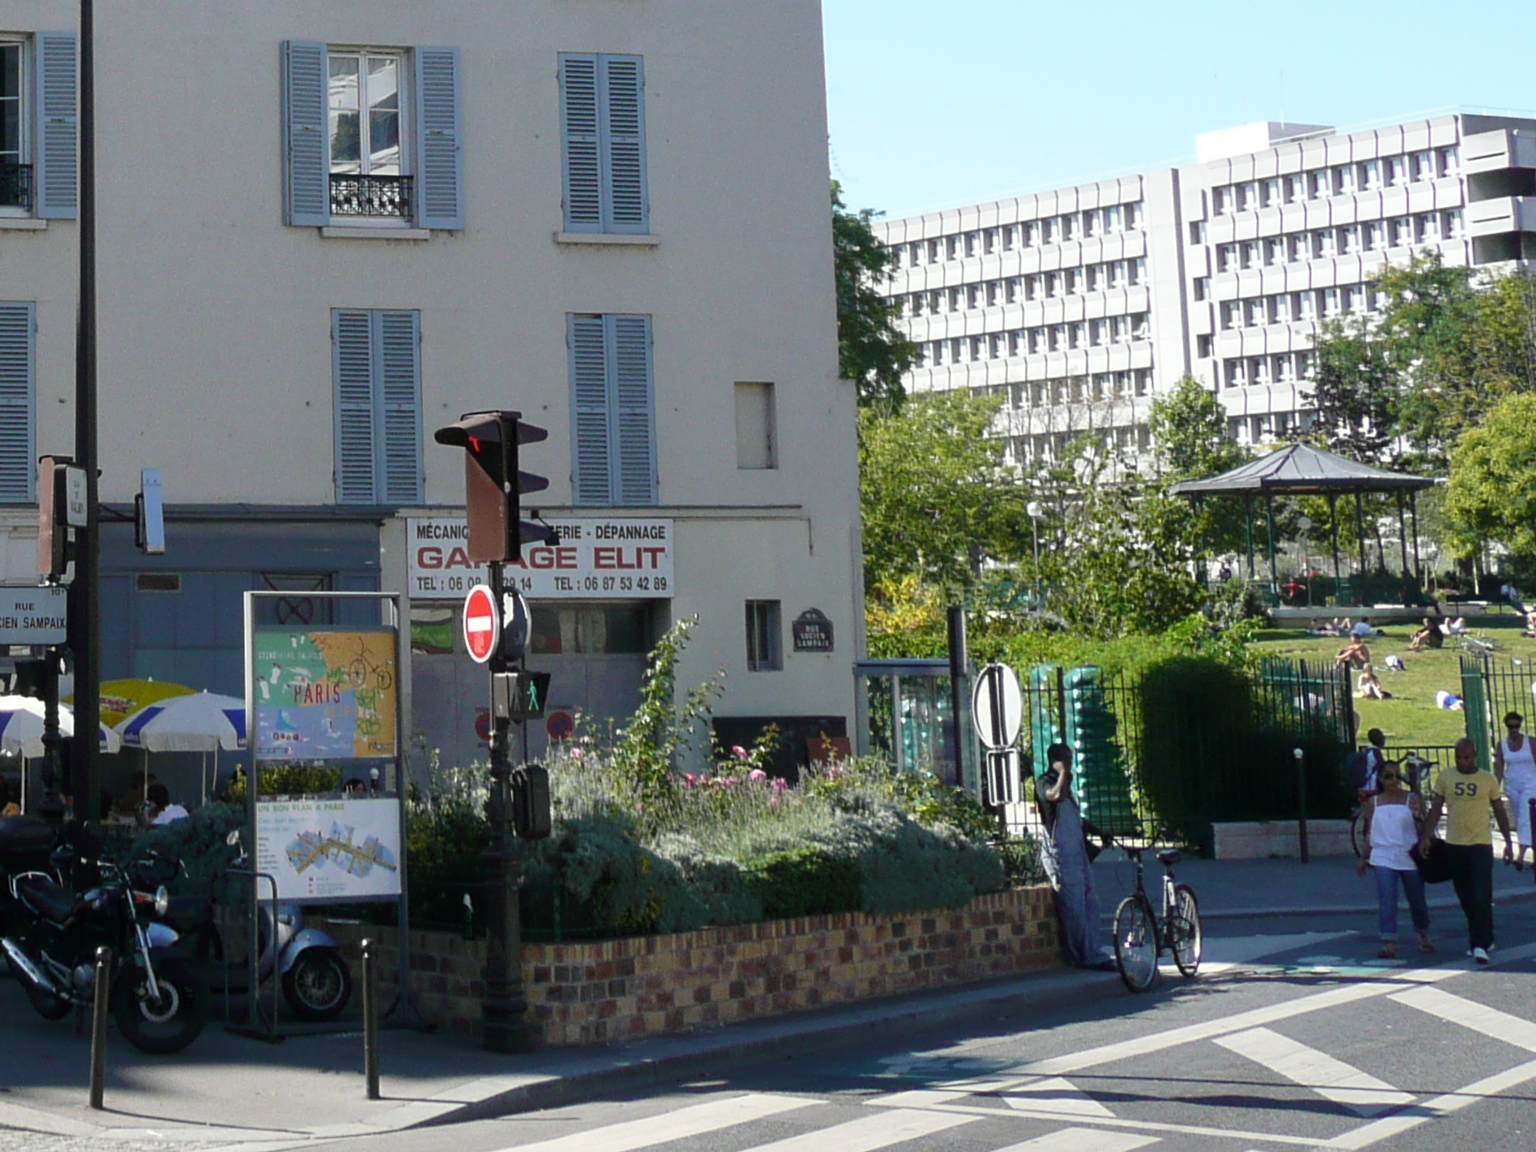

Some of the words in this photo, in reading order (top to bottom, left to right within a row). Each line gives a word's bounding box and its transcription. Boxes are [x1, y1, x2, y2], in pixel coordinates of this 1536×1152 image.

[553, 525, 582, 539] ERIE
[596, 522, 666, 539] DÉPANNAGE
[417, 547, 577, 569] GAAGE
[594, 547, 666, 569] ELIT
[417, 576, 437, 591] TEL
[448, 576, 463, 591] 06
[520, 577, 532, 591] 14
[554, 576, 574, 591] TEL
[584, 576, 598, 591] 06
[603, 576, 615, 591] 87
[620, 576, 632, 591] 53
[637, 576, 649, 591] 42
[654, 576, 667, 591] 89
[15, 603, 35, 611] RUE
[23, 617, 65, 629] SAMPAIX
[294, 682, 341, 704] PARIS
[1454, 782, 1477, 797] 59
